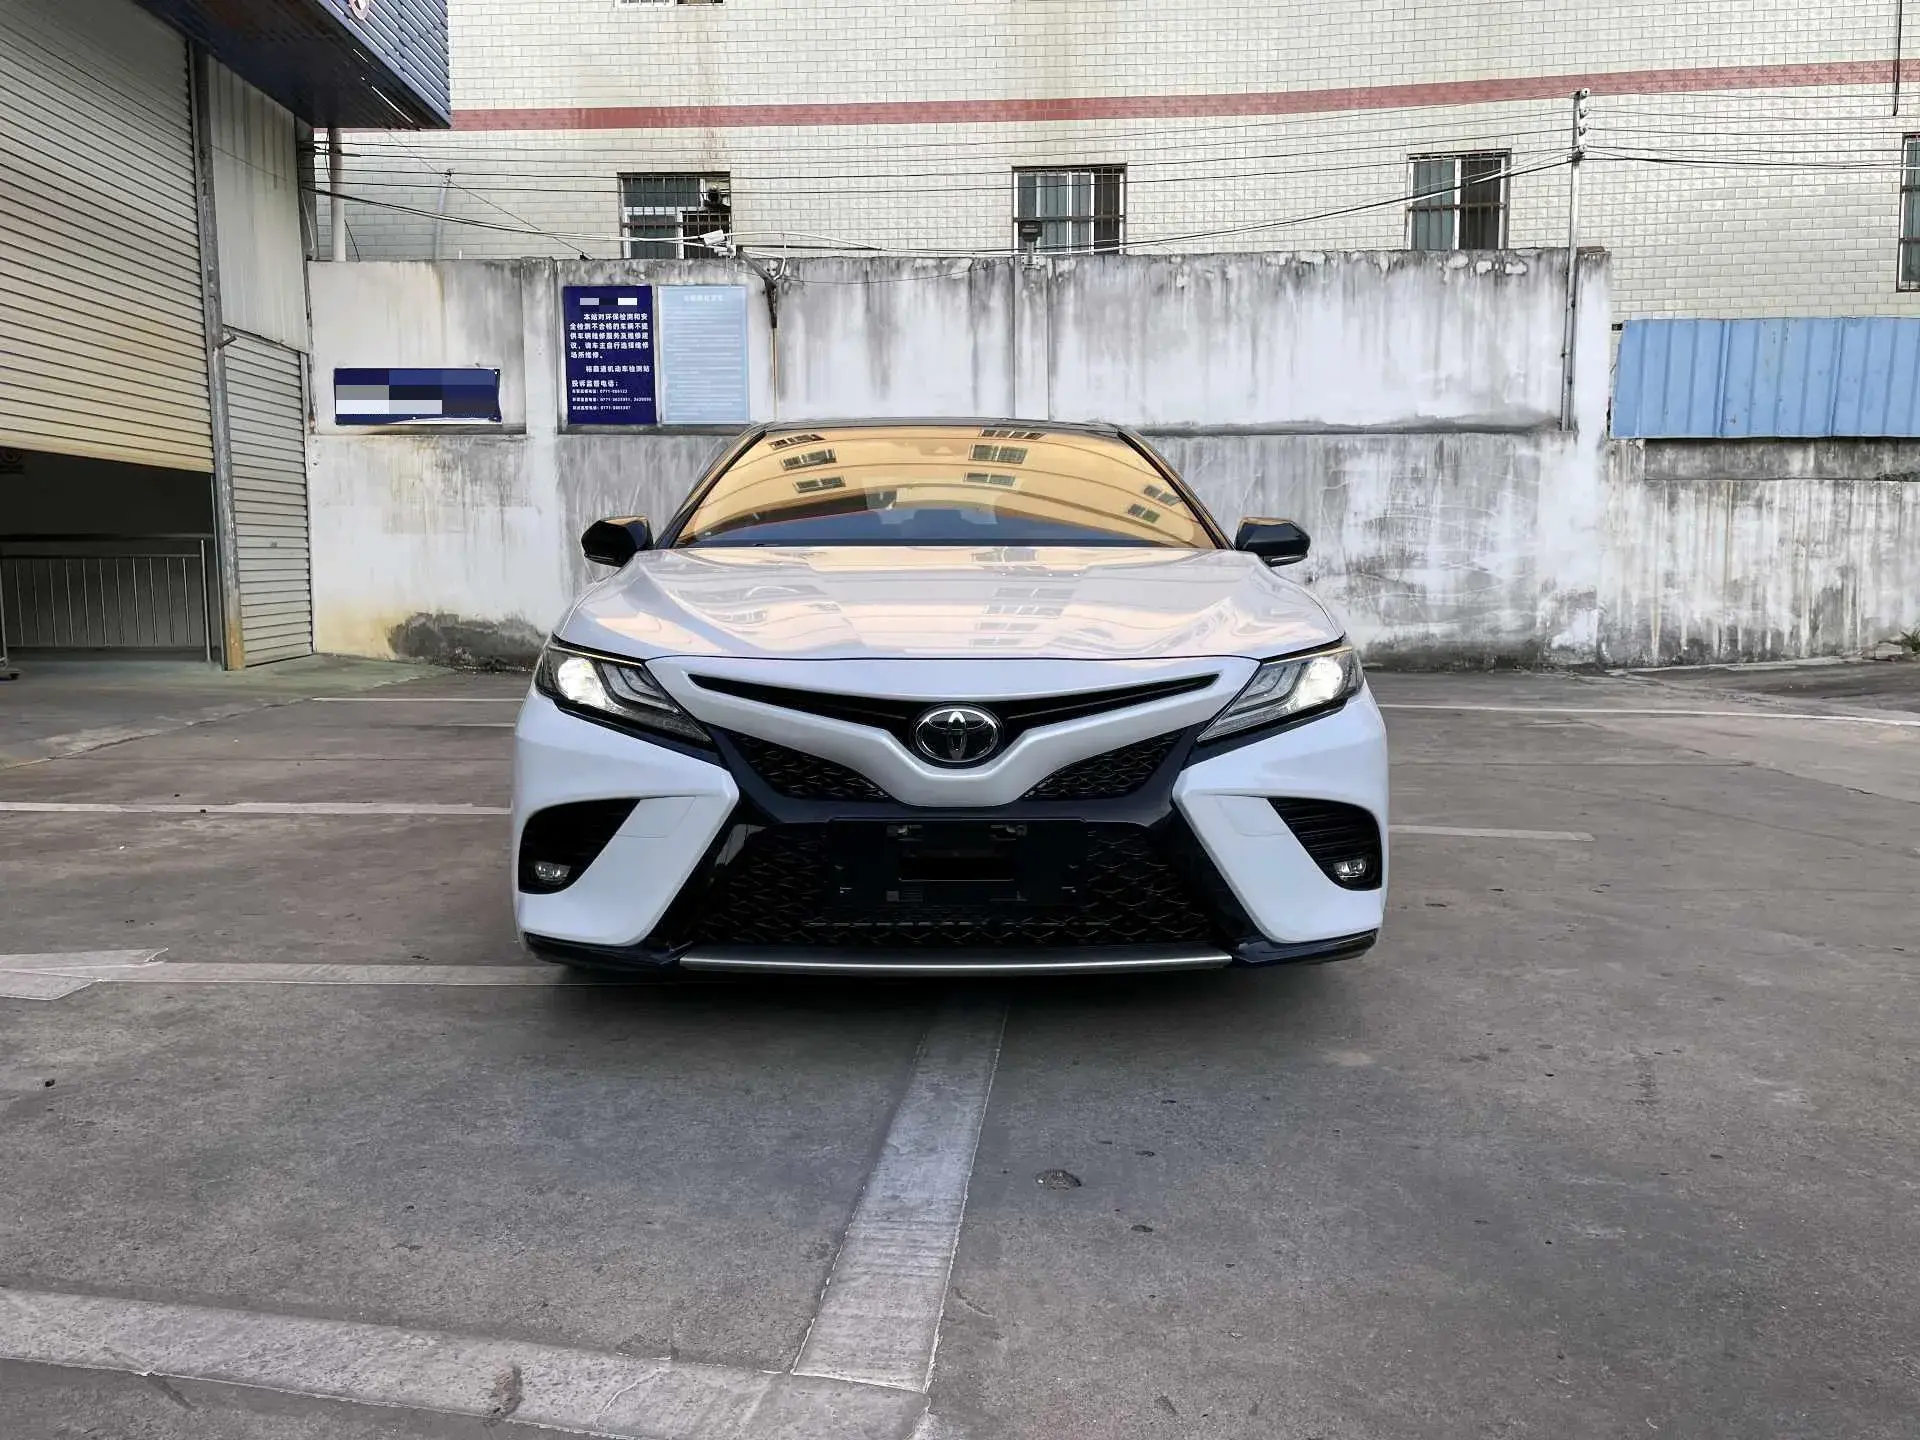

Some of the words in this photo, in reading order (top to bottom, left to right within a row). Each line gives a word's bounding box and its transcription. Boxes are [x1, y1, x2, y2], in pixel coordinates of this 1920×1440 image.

[585, 365, 650, 373] 机动车检测站
